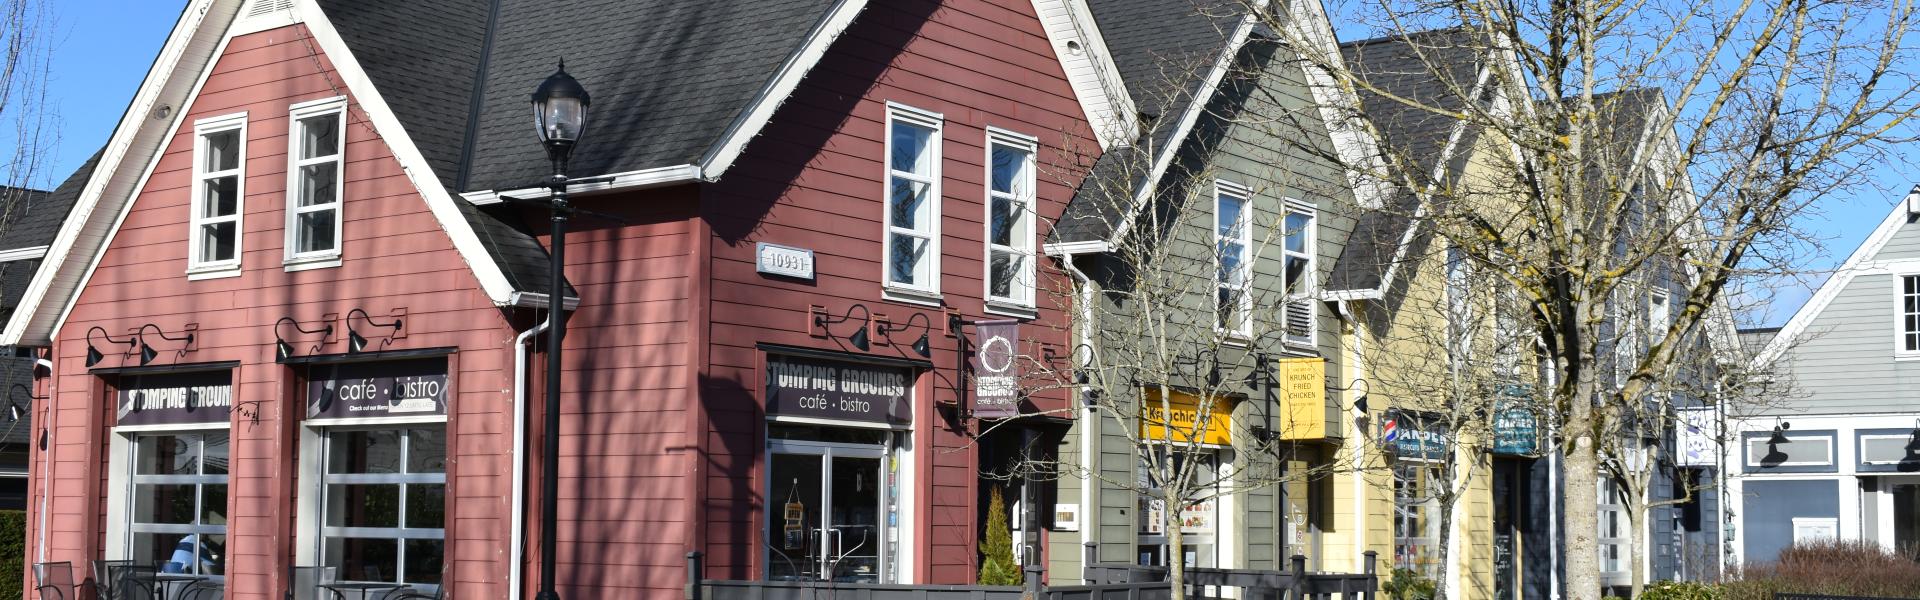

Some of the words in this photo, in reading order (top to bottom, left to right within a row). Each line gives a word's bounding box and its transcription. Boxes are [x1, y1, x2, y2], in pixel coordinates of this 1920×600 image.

[770, 252, 804, 271] 10931
[765, 361, 836, 392] STOMPING
[841, 368, 905, 397] GROUNDS
[1289, 373, 1316, 381] KRUNCH
[1293, 382, 1312, 390] FRIED
[128, 387, 187, 411] STOMPING
[190, 384, 232, 408] GROUN
[339, 377, 377, 401] café
[394, 376, 440, 399] bistro
[1289, 391, 1316, 399] CHICKEN
[799, 393, 828, 410] café
[840, 395, 871, 413] bistro
